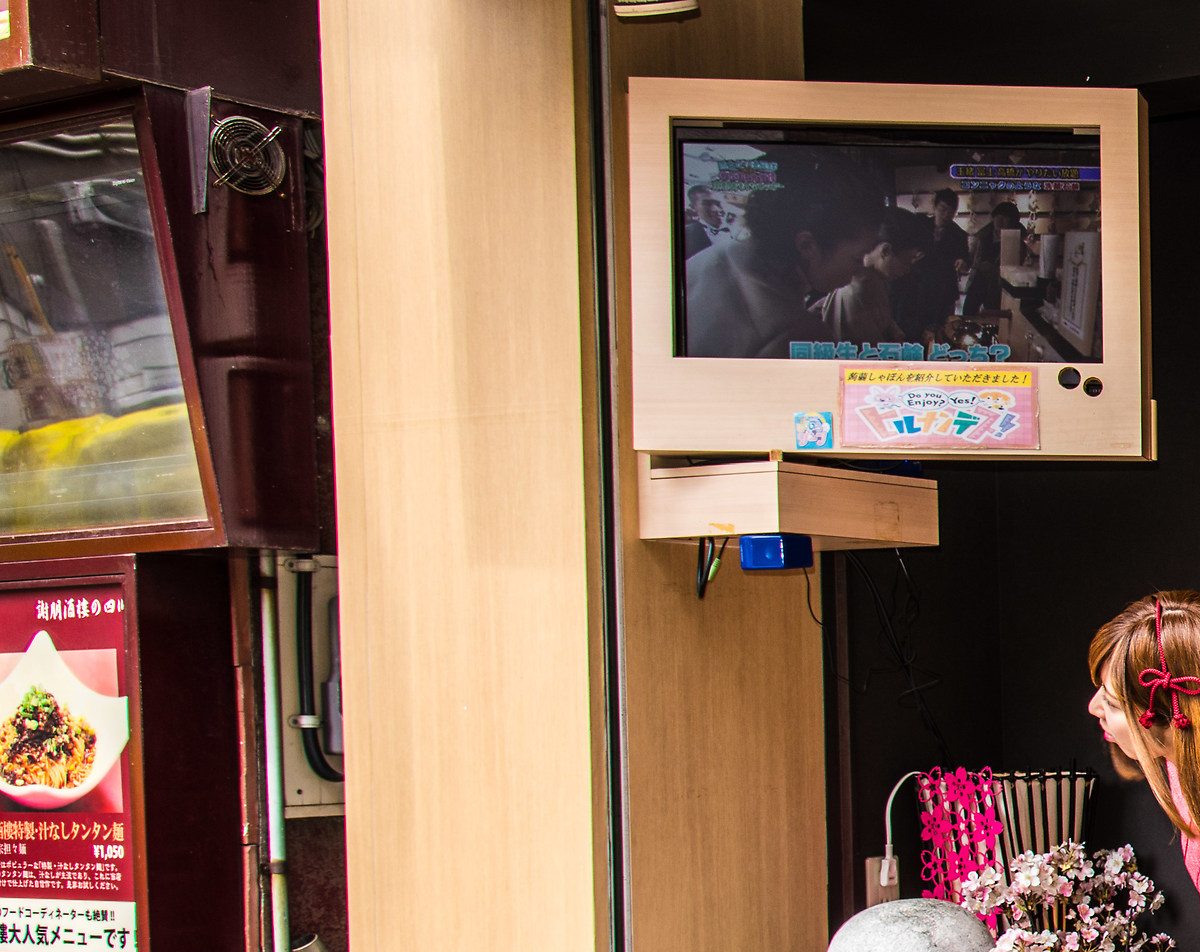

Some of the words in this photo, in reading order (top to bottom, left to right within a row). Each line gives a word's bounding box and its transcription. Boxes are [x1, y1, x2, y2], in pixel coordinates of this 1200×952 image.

[908, 391, 923, 399] Do
[924, 392, 942, 400] you
[907, 398, 945, 407] Enjoy?
[950, 396, 976, 406] Yes!
[93, 844, 125, 860] ¥1,050
